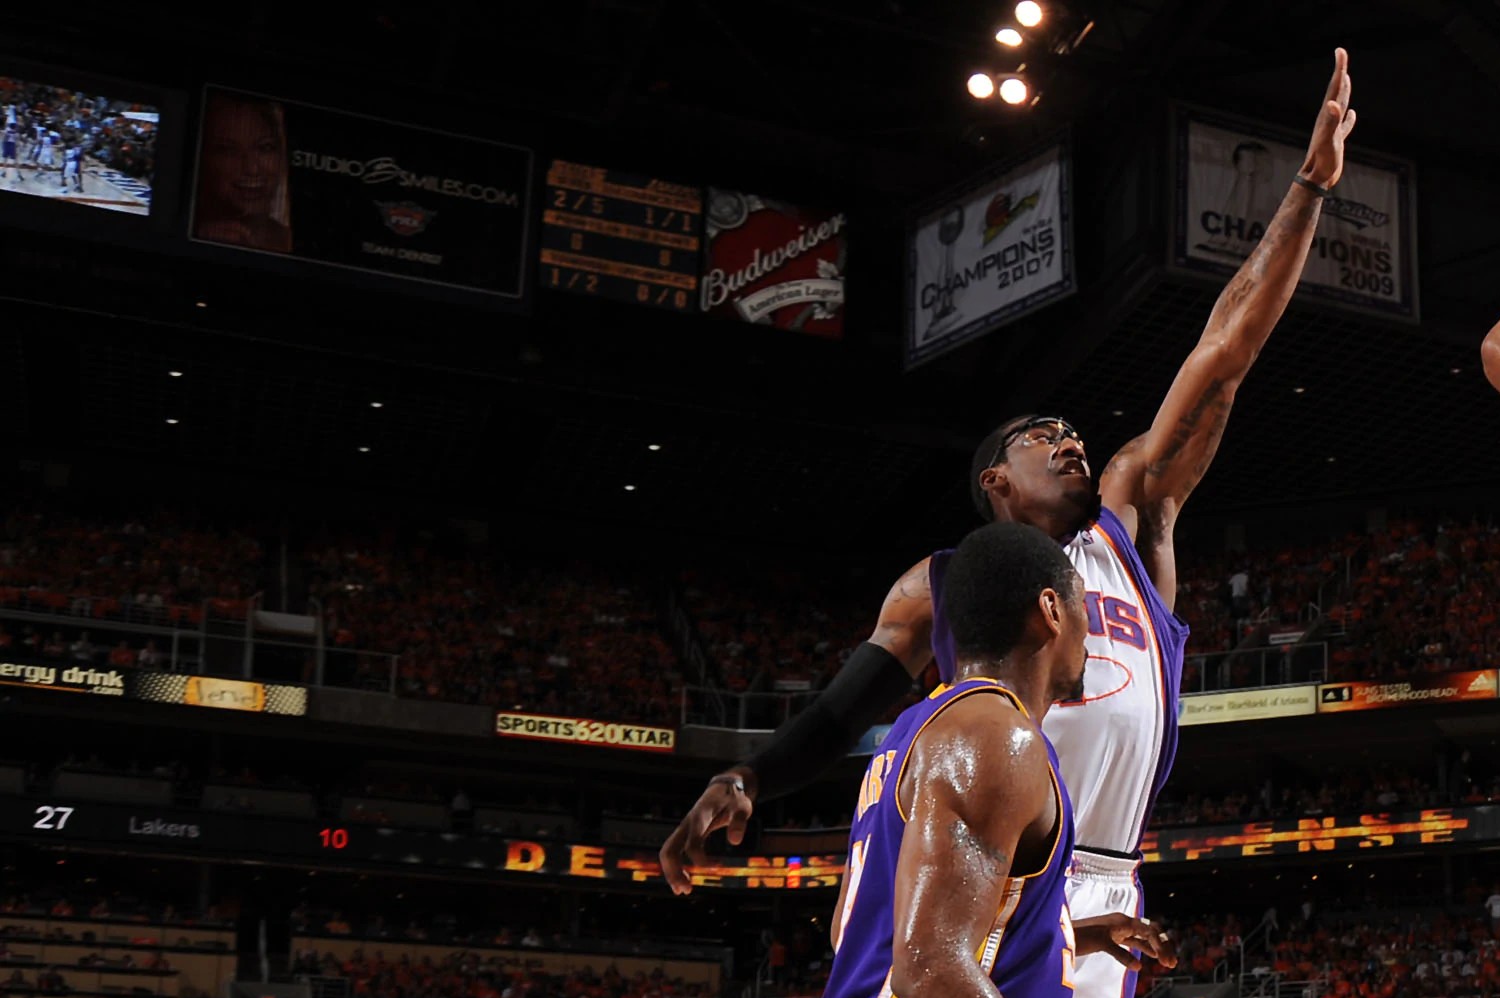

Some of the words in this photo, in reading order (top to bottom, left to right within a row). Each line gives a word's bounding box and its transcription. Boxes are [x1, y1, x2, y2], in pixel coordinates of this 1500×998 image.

[291, 150, 365, 177] STUDIO
[701, 211, 847, 312] Budweiser
[920, 227, 1055, 310] CHAMPIONS
[998, 250, 1055, 289] 2007
[1340, 267, 1394, 296] 2009
[62, 667, 125, 688] drink
[87, 683, 125, 697] .com
[500, 716, 574, 737] SPORTS
[574, 720, 621, 745] 620
[621, 727, 671, 747] KTAR
[32, 804, 75, 831] 27
[128, 815, 200, 839] Lakers
[318, 826, 349, 850] 10
